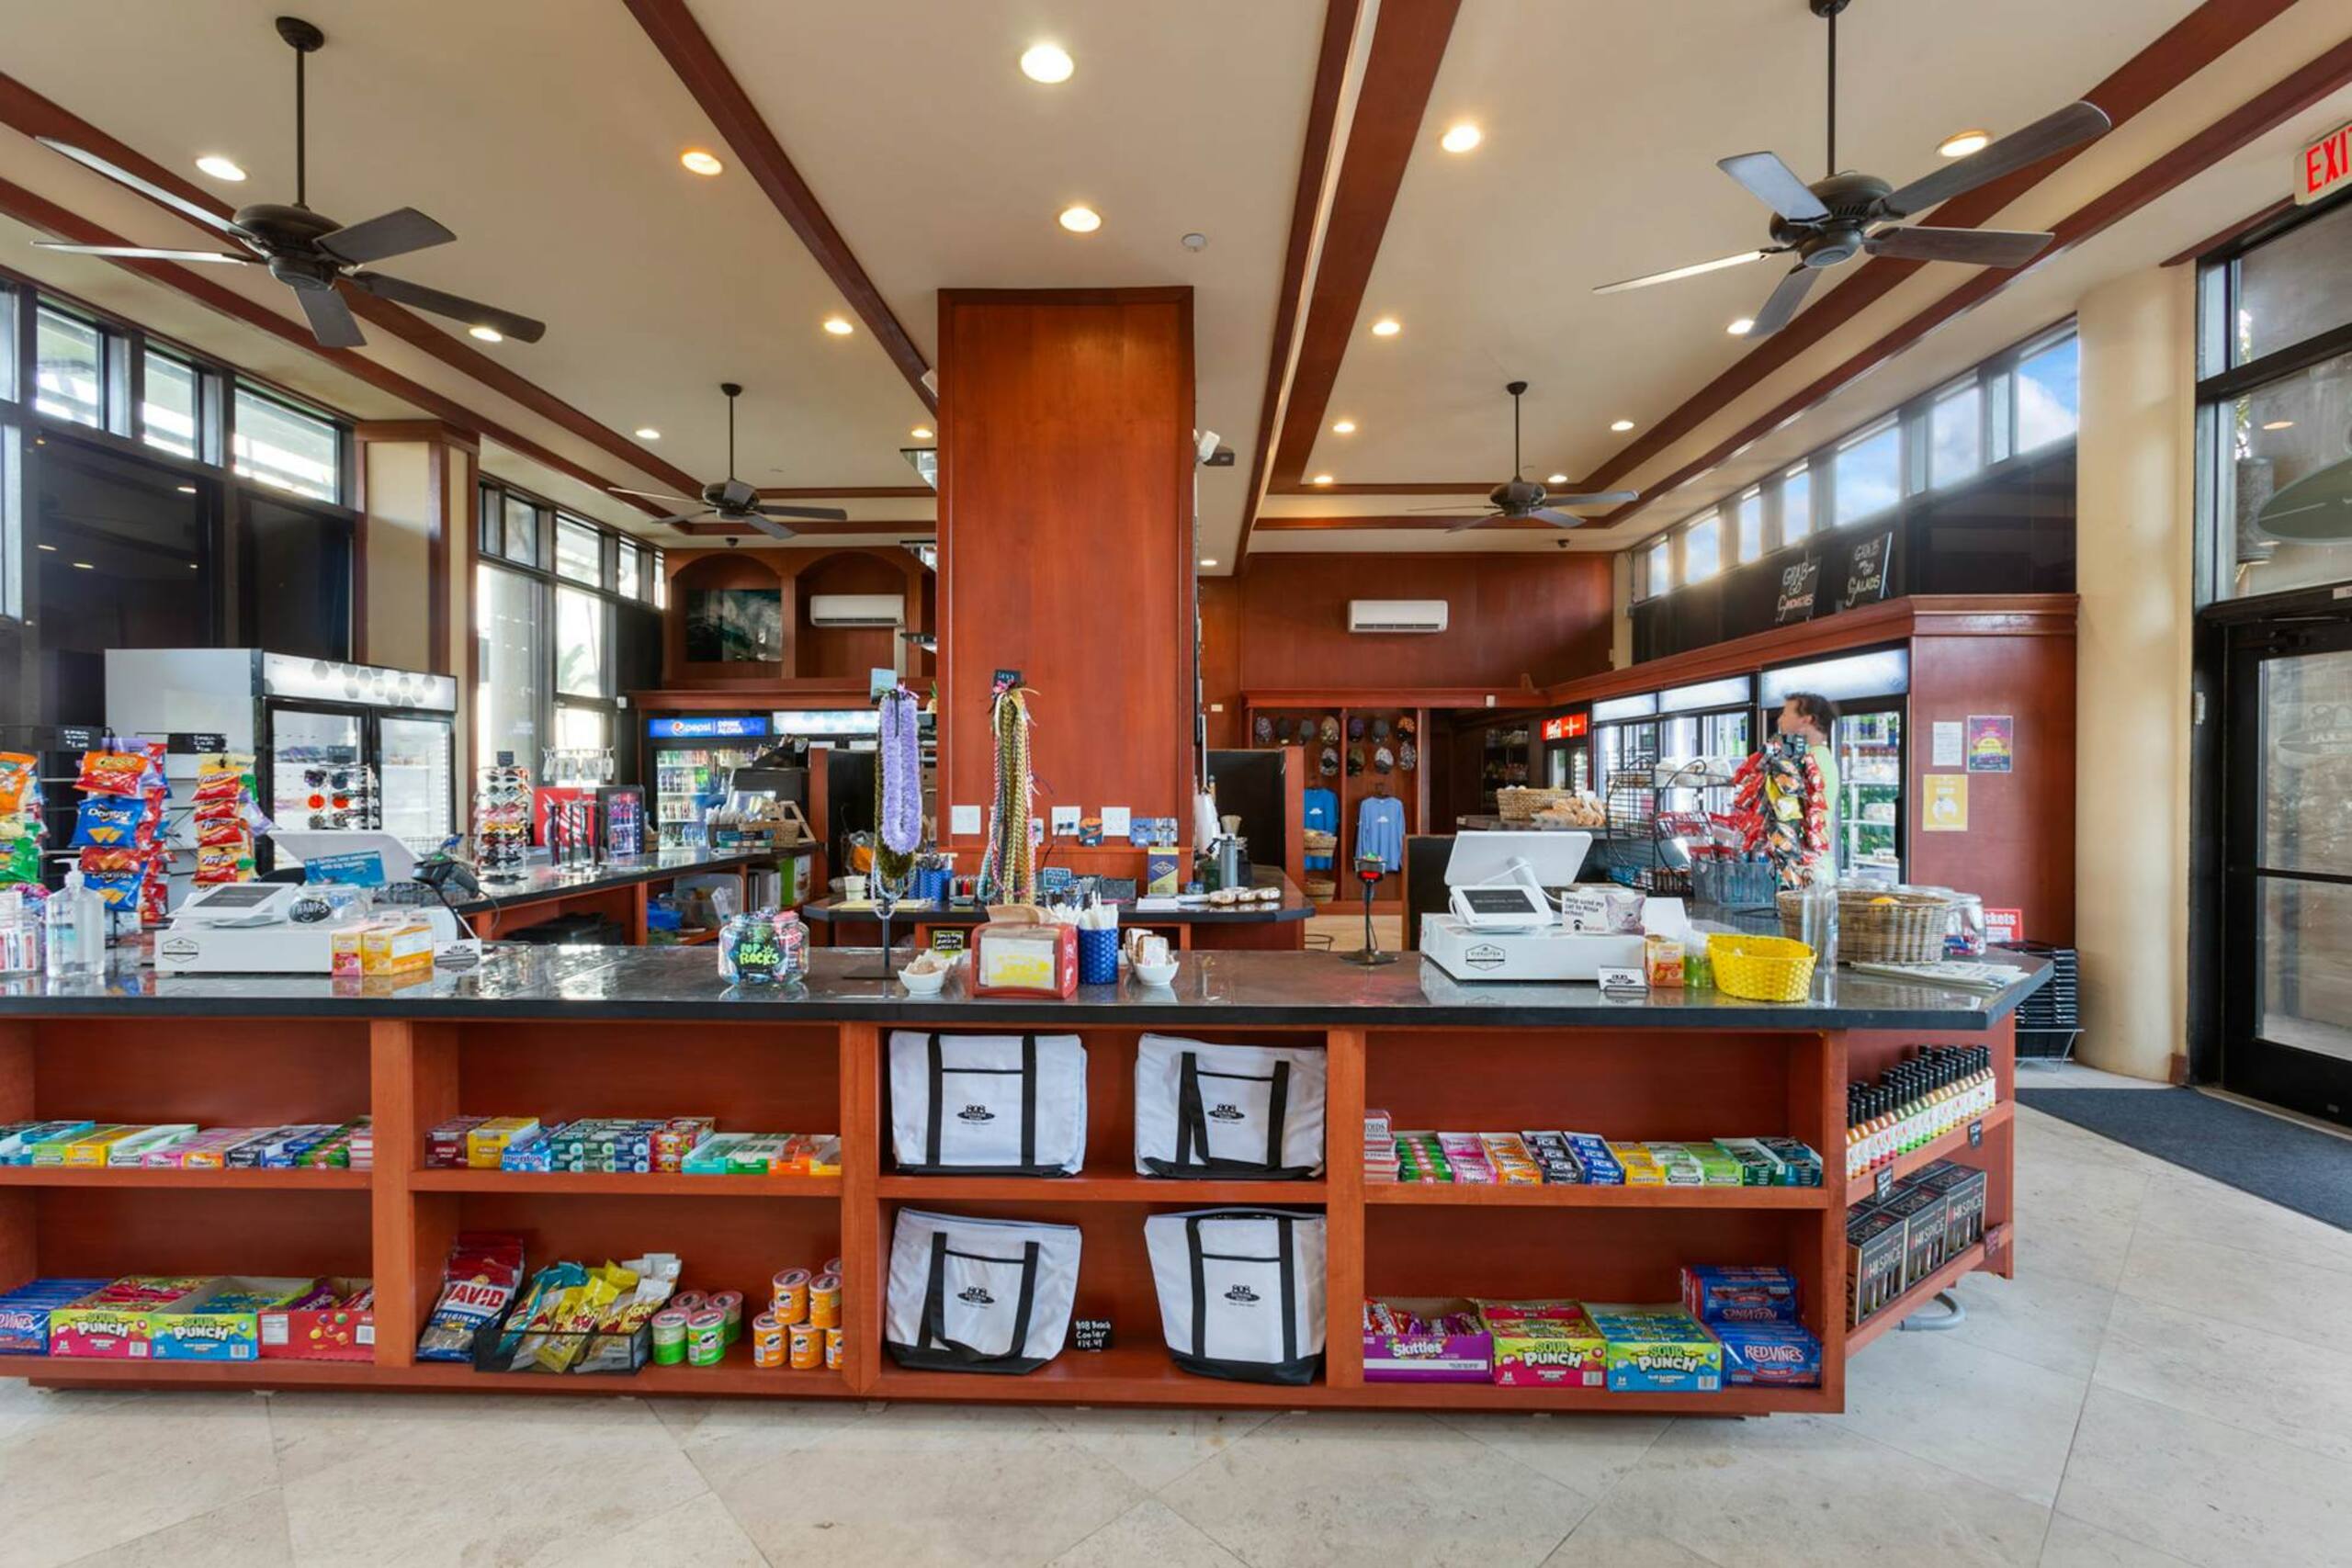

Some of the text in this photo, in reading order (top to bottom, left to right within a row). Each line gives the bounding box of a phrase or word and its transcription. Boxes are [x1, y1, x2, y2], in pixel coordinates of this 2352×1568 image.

[684, 722, 711, 732] pepsi
[739, 952, 780, 966] ROCKS
[77, 1322, 129, 1337] PUNCH
[173, 1325, 229, 1341] PUNCH
[1393, 1342, 1442, 1357] Skittles
[1535, 1341, 1569, 1352] SOUR
[1649, 1346, 1684, 1357] SOUR
[1523, 1352, 1582, 1368] PUNCH
[1637, 1356, 1698, 1373] PUNCH
